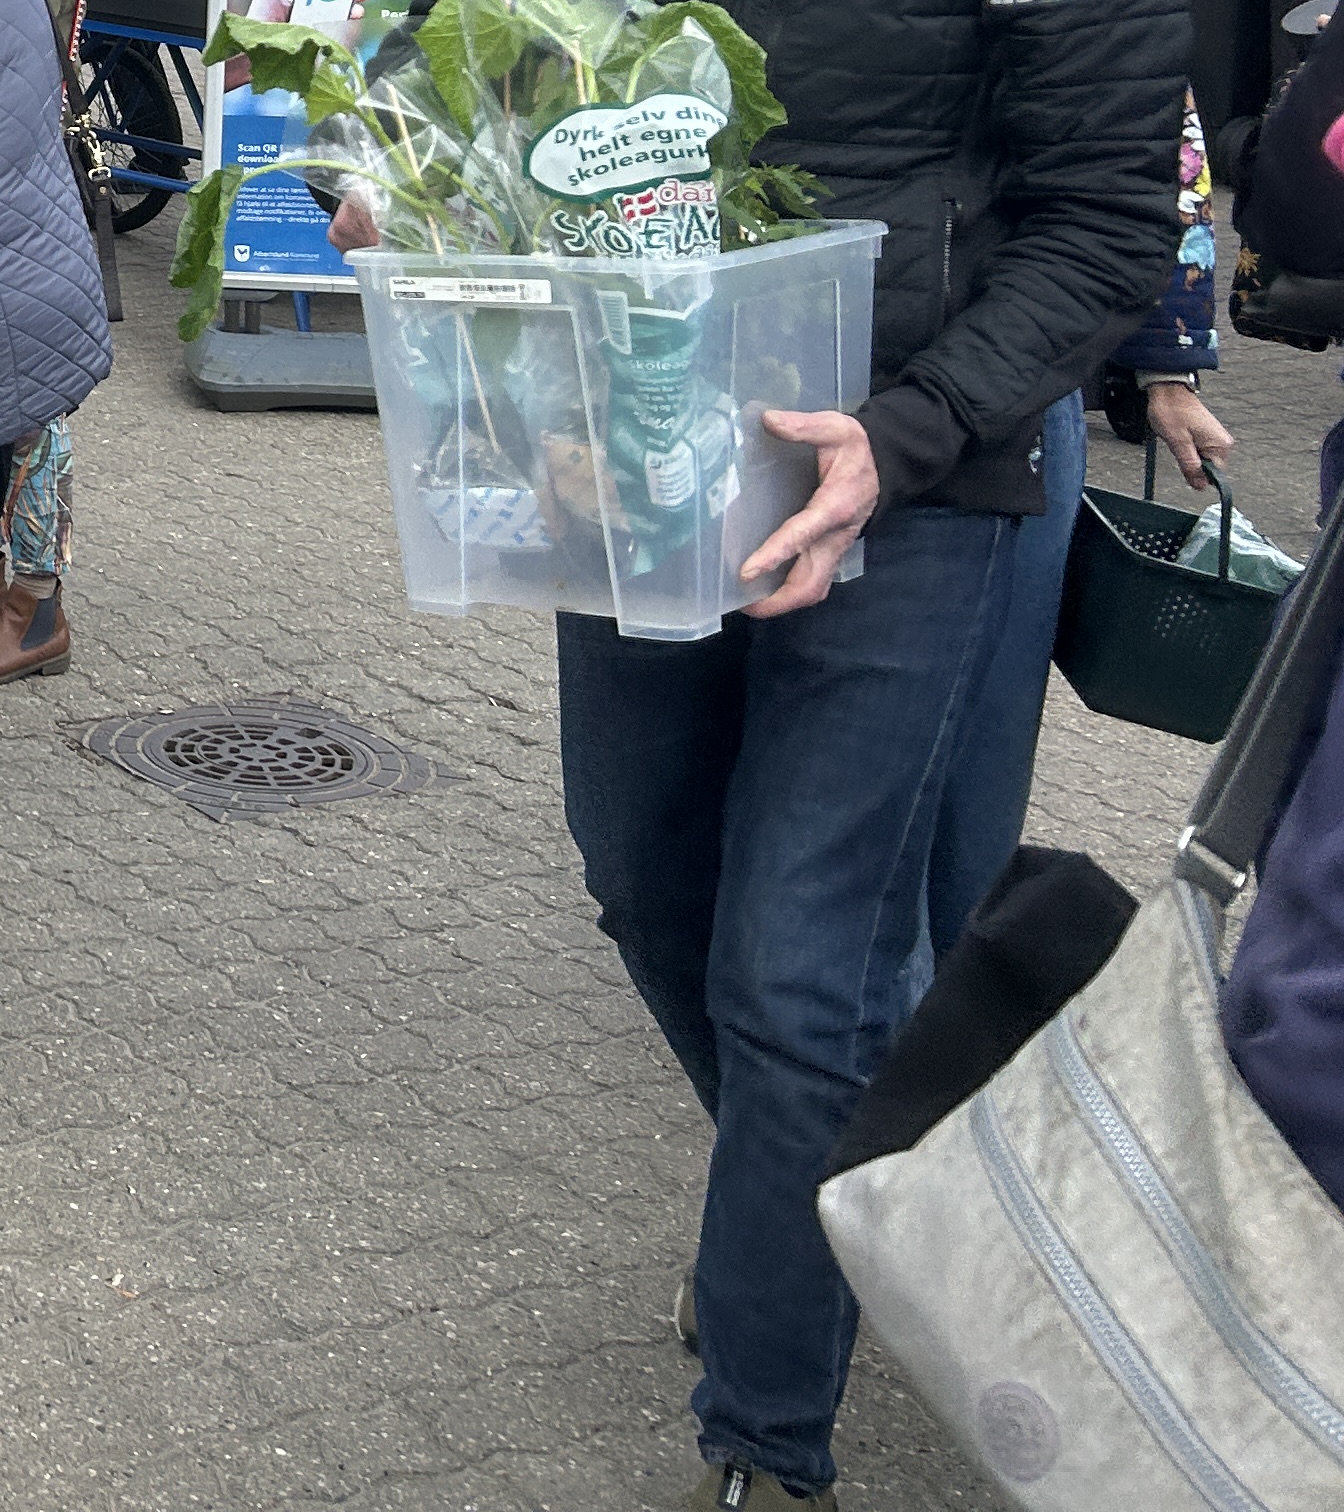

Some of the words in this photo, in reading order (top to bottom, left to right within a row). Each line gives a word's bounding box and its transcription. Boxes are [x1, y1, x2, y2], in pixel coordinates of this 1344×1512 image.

[613, 109, 666, 131] selv
[237, 143, 261, 153] Scan
[262, 143, 277, 153] QR
[578, 133, 632, 162] helt
[640, 126, 707, 145] egne
